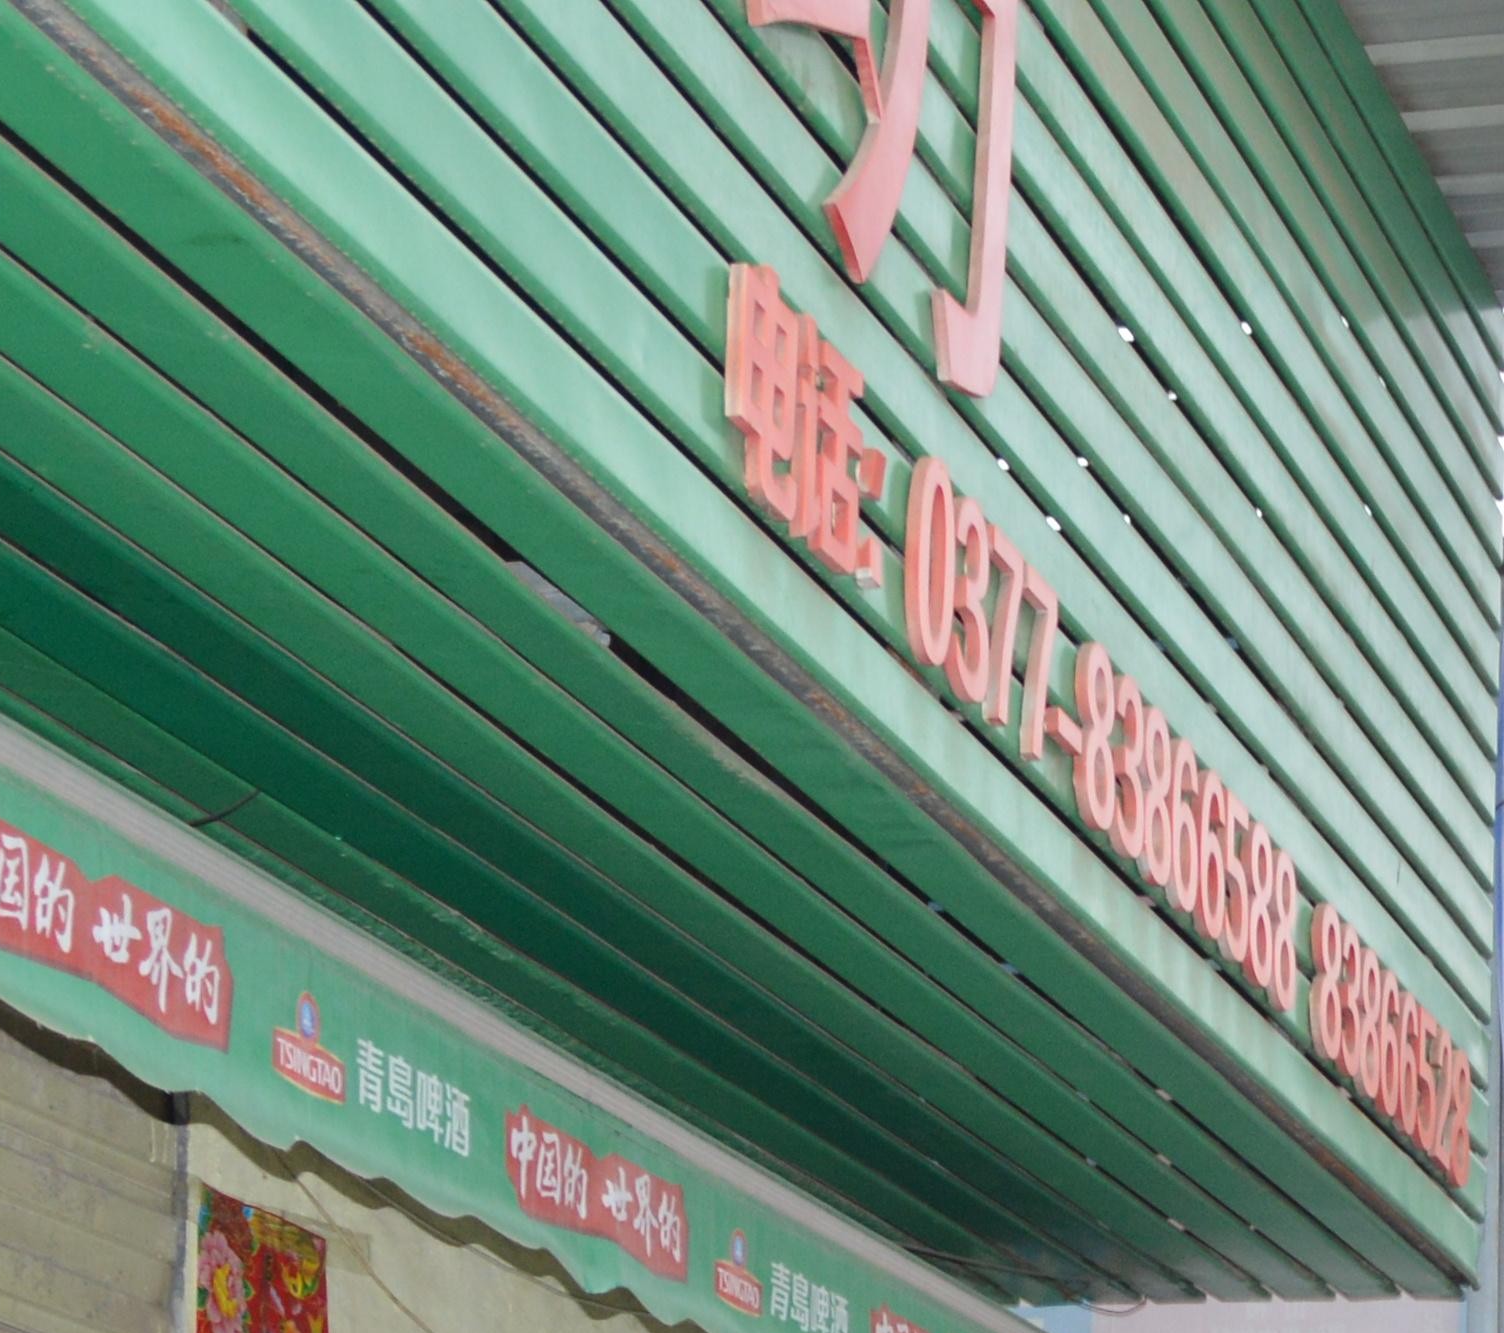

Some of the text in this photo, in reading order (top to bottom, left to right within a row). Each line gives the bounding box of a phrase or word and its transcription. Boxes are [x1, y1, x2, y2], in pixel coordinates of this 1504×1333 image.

[905, 456, 1297, 1012] 0377-83866588
[1309, 903, 1472, 1189] 83866528
[93, 897, 222, 1025] 世界的
[277, 1035, 343, 1095] TSINGTAO
[511, 1116, 681, 1263] 中国的 世界的
[717, 1266, 760, 1309] TSINGTAO
